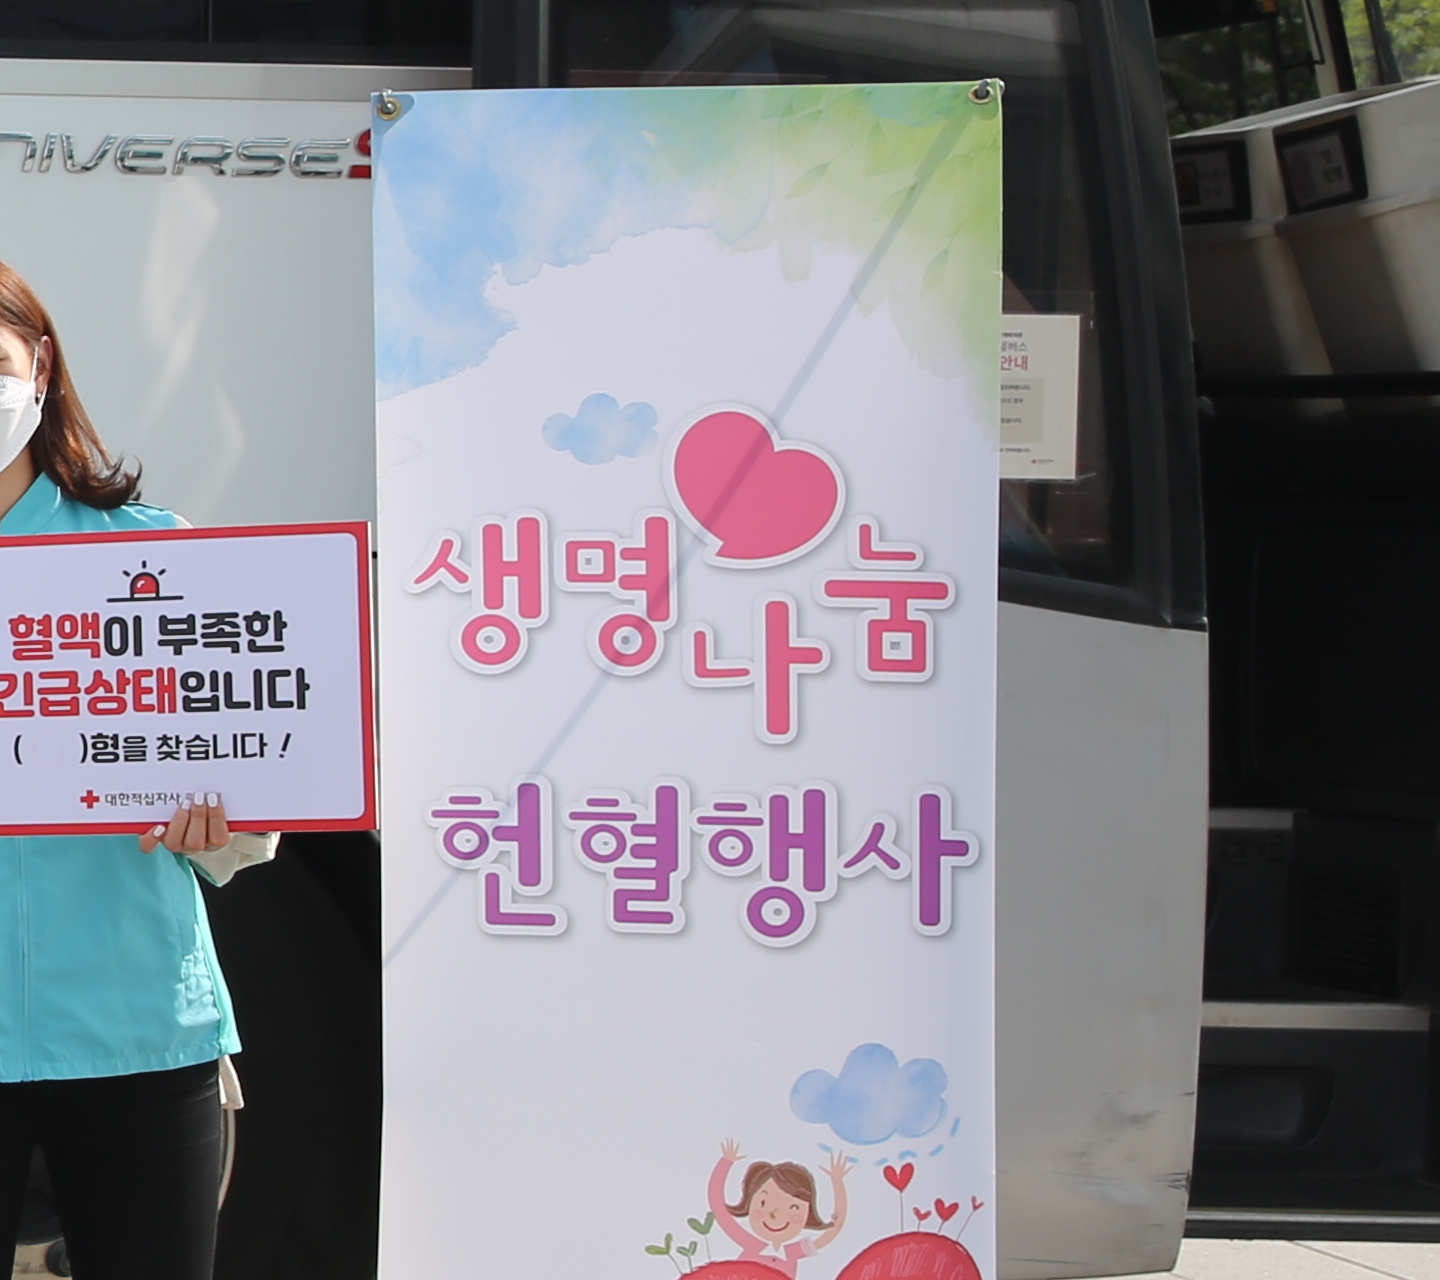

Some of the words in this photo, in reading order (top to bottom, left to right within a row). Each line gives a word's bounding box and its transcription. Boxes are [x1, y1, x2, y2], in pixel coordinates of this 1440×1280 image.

[8, 611, 144, 661] 혈액이
[157, 609, 288, 655] 부족한
[104, 792, 181, 807] 대한적십자사
[430, 782, 970, 939] 헌혈행사
